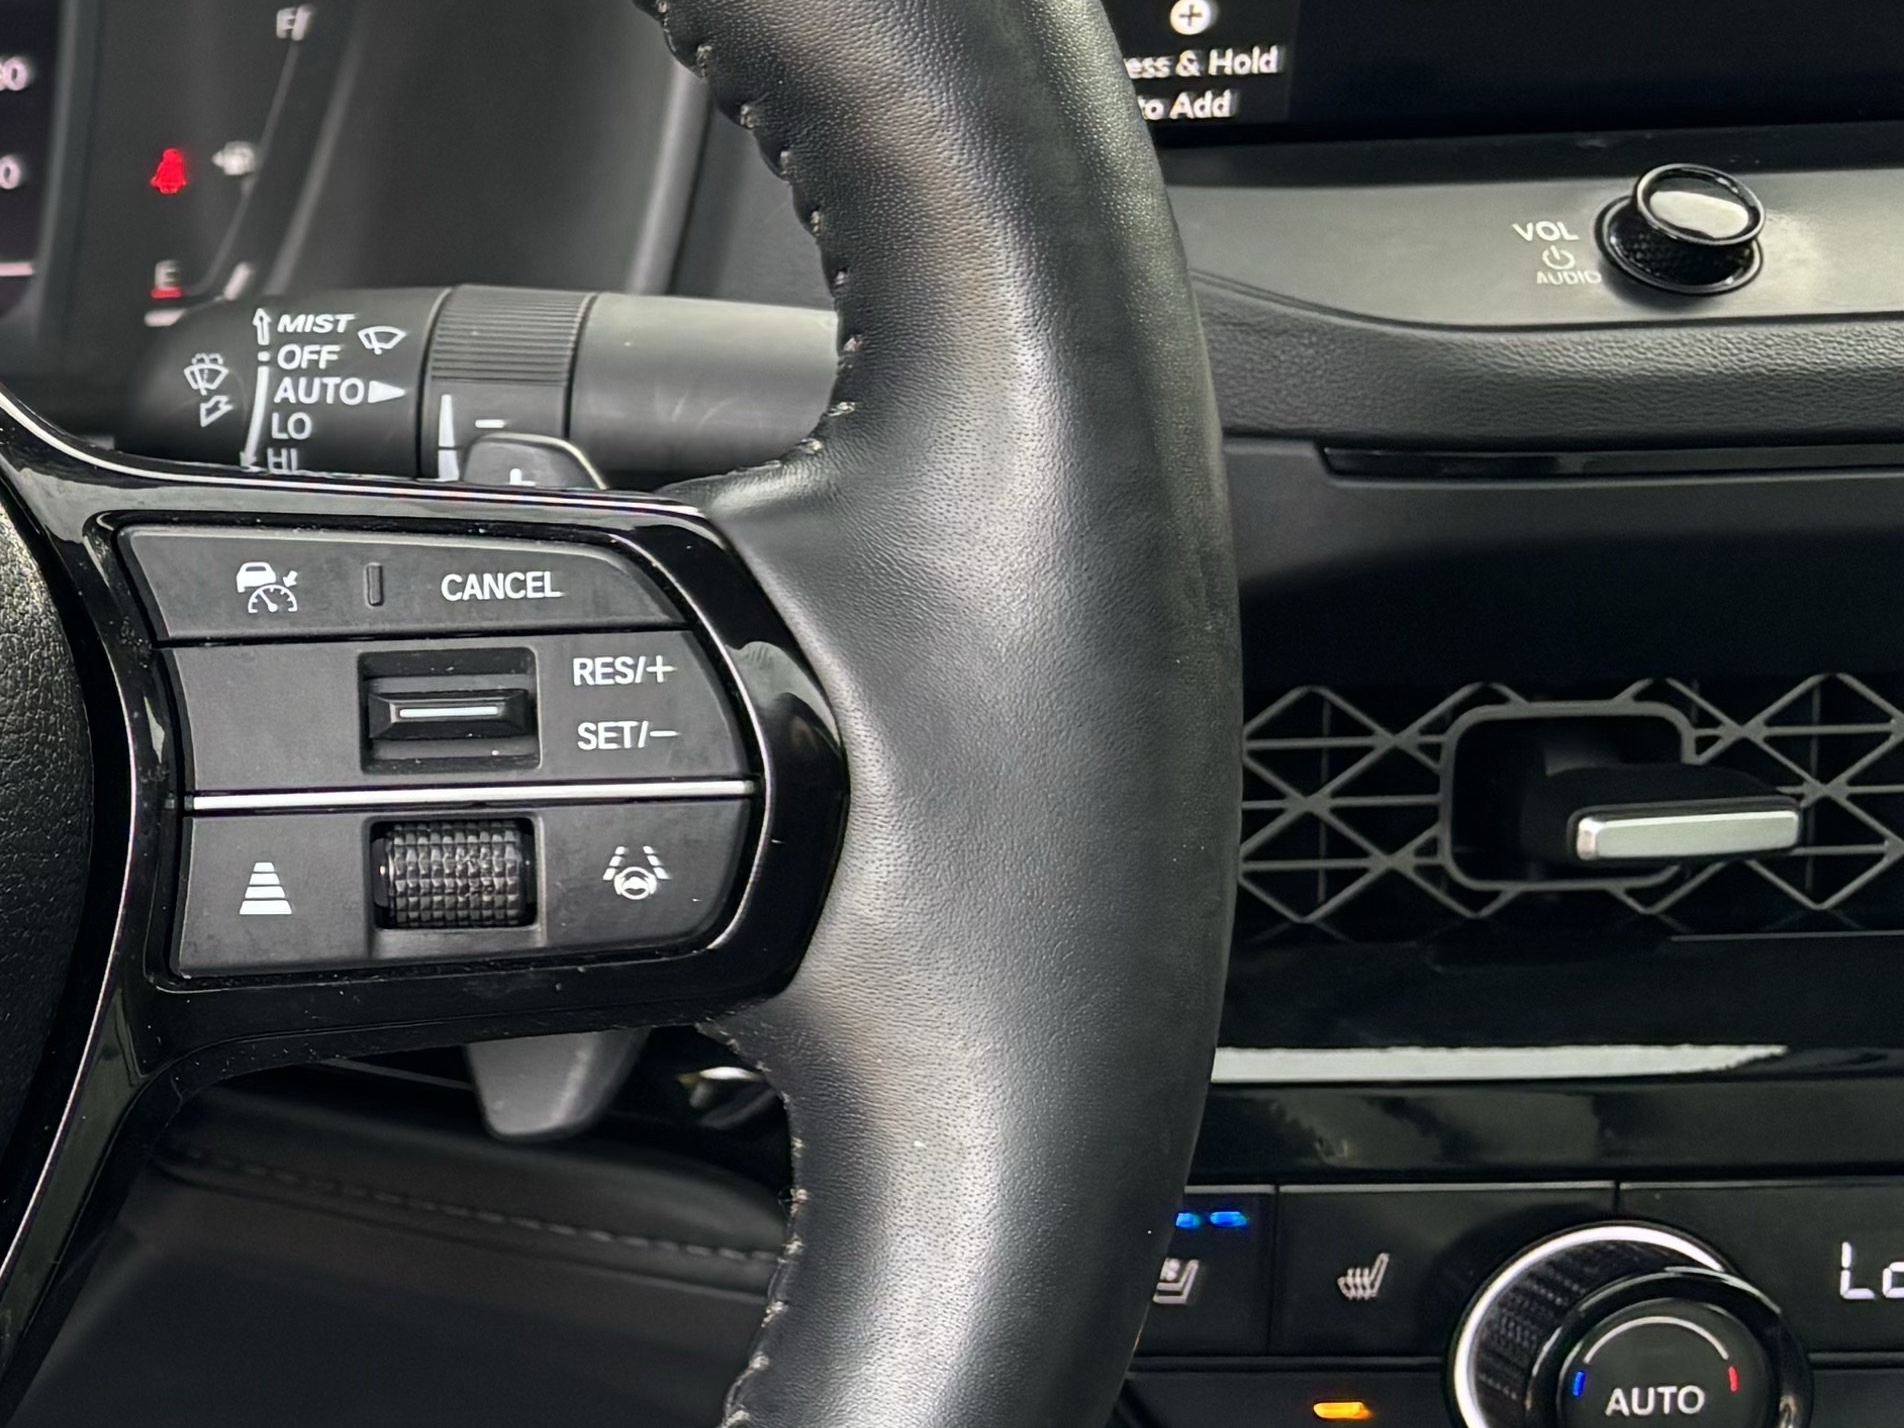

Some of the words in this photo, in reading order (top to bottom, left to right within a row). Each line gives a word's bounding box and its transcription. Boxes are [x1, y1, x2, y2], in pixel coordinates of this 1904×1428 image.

[1126, 52, 1171, 80] ess
[1209, 47, 1281, 77] Hold
[1140, 96, 1165, 121] to
[1170, 91, 1234, 121] Add
[1513, 220, 1580, 244] VOL
[1536, 269, 1603, 287] AUDIO
[277, 312, 356, 335] MIST
[277, 344, 340, 371] OFF
[274, 377, 368, 406] AUTO
[271, 411, 313, 441] LO
[266, 447, 299, 473] HI
[440, 572, 563, 603] CANCEL
[572, 655, 680, 686] RES/+
[1604, 1384, 1707, 1418] AUTO
